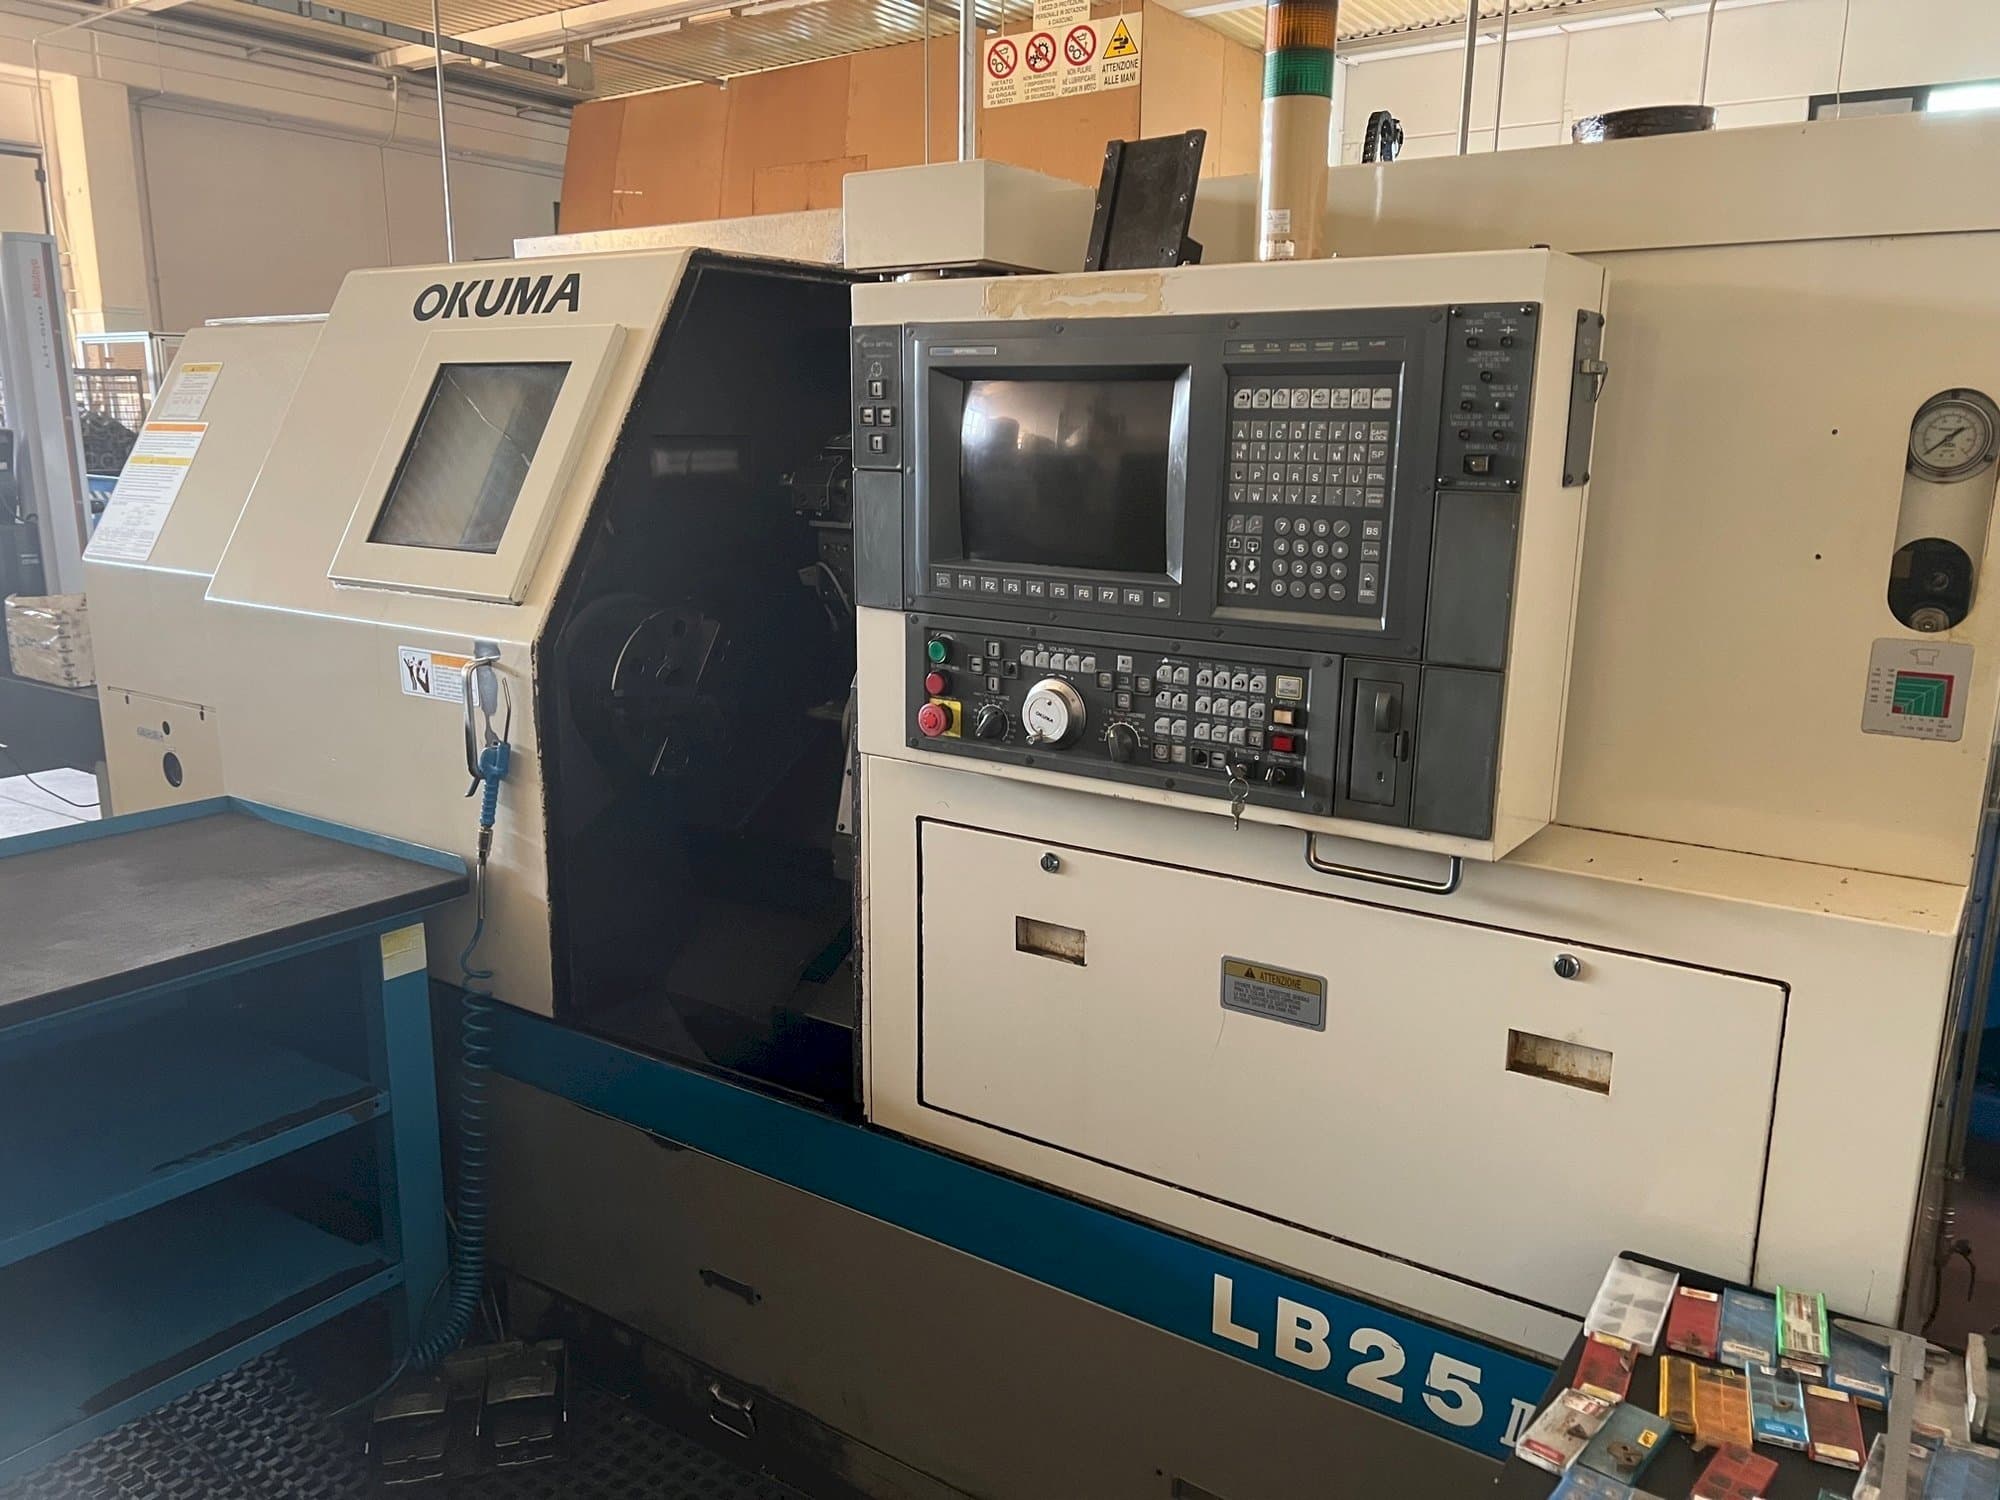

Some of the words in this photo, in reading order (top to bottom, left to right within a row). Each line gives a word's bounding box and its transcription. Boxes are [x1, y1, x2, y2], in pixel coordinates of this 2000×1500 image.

[1102, 58, 1139, 74] ATTENZIONE
[991, 79, 1014, 87] VIETATO
[1103, 75, 1119, 86] ALLE
[1120, 73, 1136, 83] MANI
[988, 85, 1015, 94] OPERARE
[995, 90, 1016, 99] ORGANI
[413, 273, 580, 321] OKUMA
[1237, 430, 1244, 438] A
[1256, 430, 1263, 438] B
[1275, 430, 1282, 438] C
[1294, 430, 1302, 439] D
[1314, 430, 1321, 439] E
[1335, 430, 1342, 439] F
[1354, 431, 1362, 440] G
[1236, 451, 1243, 459] H
[1274, 451, 1281, 460] J
[1293, 452, 1300, 460] K
[1313, 452, 1319, 460] L
[1332, 452, 1341, 461] M
[1353, 453, 1360, 461] N
[1371, 450, 1385, 458] SP
[1253, 472, 1261, 480] P
[1272, 472, 1280, 480] Q
[1292, 472, 1299, 481] R
[1312, 473, 1319, 482] S
[1332, 474, 1339, 482] T
[1352, 474, 1359, 483] U
[1368, 473, 1385, 481] CTRL
[1234, 492, 1240, 500] V
[1252, 492, 1260, 501] W
[1271, 493, 1279, 502] X
[1291, 494, 1298, 502] Y
[1310, 494, 1317, 503] Z
[1280, 522, 1287, 531] 7
[1299, 523, 1305, 532] 8
[1318, 524, 1326, 533] 9
[1338, 525, 1346, 533] /
[1366, 527, 1378, 536] BS
[1278, 543, 1285, 551] 4
[1297, 544, 1304, 552] 5
[1317, 545, 1324, 554] 6
[1278, 563, 1283, 572] 1
[1296, 564, 1303, 573] 2
[1315, 566, 1322, 574] 3
[1335, 568, 1342, 576] +
[962, 579, 972, 587] F1
[985, 581, 996, 590] F2
[1007, 583, 1018, 592] F3
[1030, 585, 1041, 594] F4
[1054, 587, 1065, 596] F5
[1078, 589, 1089, 598] F6
[1103, 591, 1114, 600] F7
[1128, 594, 1140, 602] F8
[1275, 583, 1282, 592] 0
[1035, 711, 1054, 723] OKUMA
[1260, 971, 1302, 989] ATTENZIONE
[1212, 1273, 1484, 1427] LB25
